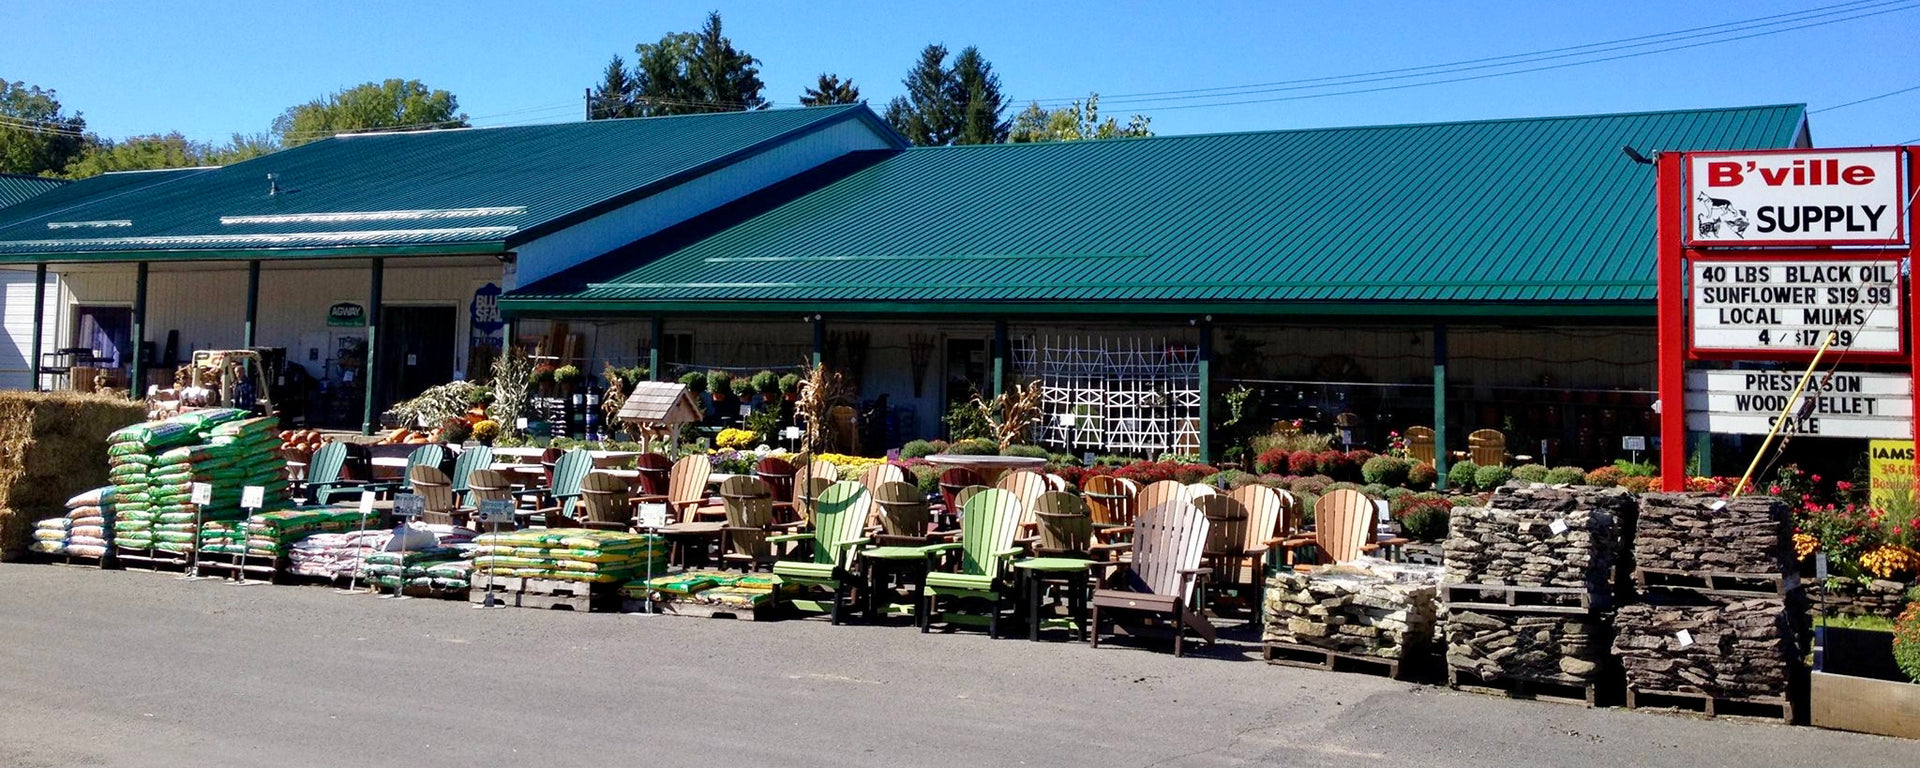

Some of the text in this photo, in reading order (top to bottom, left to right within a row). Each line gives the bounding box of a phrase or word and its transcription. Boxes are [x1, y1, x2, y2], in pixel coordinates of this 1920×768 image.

[1708, 159, 1876, 187] B'ville
[1757, 204, 1888, 233] SUPPLY
[1702, 266, 1892, 284] 40 LBS BLACK OIL
[476, 295, 499, 307] BLU
[1703, 287, 1891, 305] SUNFLOWER $19.99
[332, 306, 361, 316] AGWAY
[1719, 308, 1865, 326] LOCAL MUMS
[1758, 329, 1770, 346] 4
[1736, 395, 1788, 412] WOOD
[1873, 447, 1914, 460] IAMS
